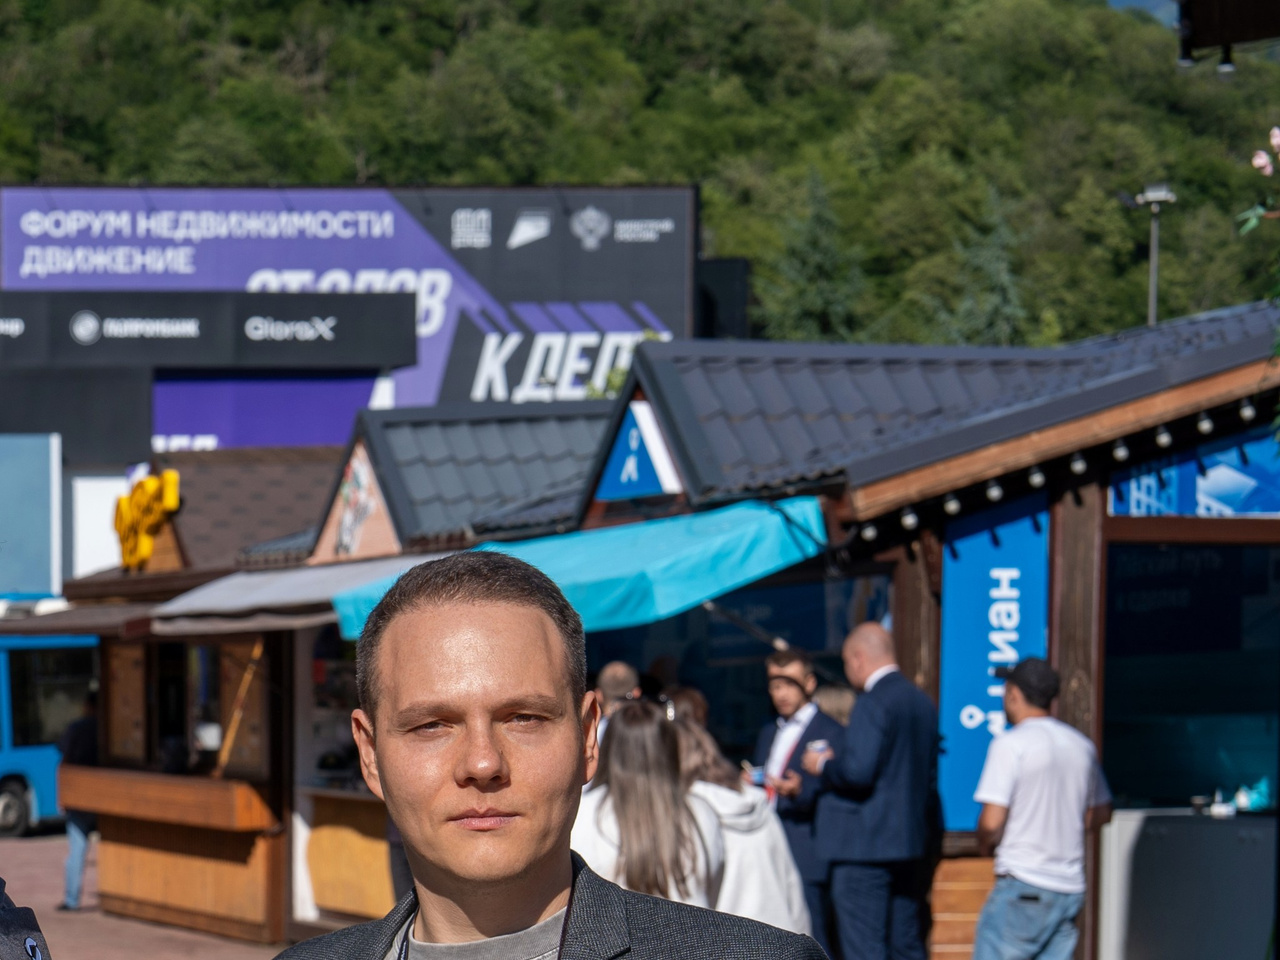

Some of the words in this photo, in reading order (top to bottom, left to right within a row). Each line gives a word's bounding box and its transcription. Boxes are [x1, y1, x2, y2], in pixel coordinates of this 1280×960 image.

[20, 210, 132, 239] ФОРУМ
[136, 210, 395, 243] НЕДВИЖИМОСТИ
[20, 246, 197, 278] ДВИЖЕНИЕ
[470, 332, 523, 402] К
[510, 331, 673, 404] ДЕЛ
